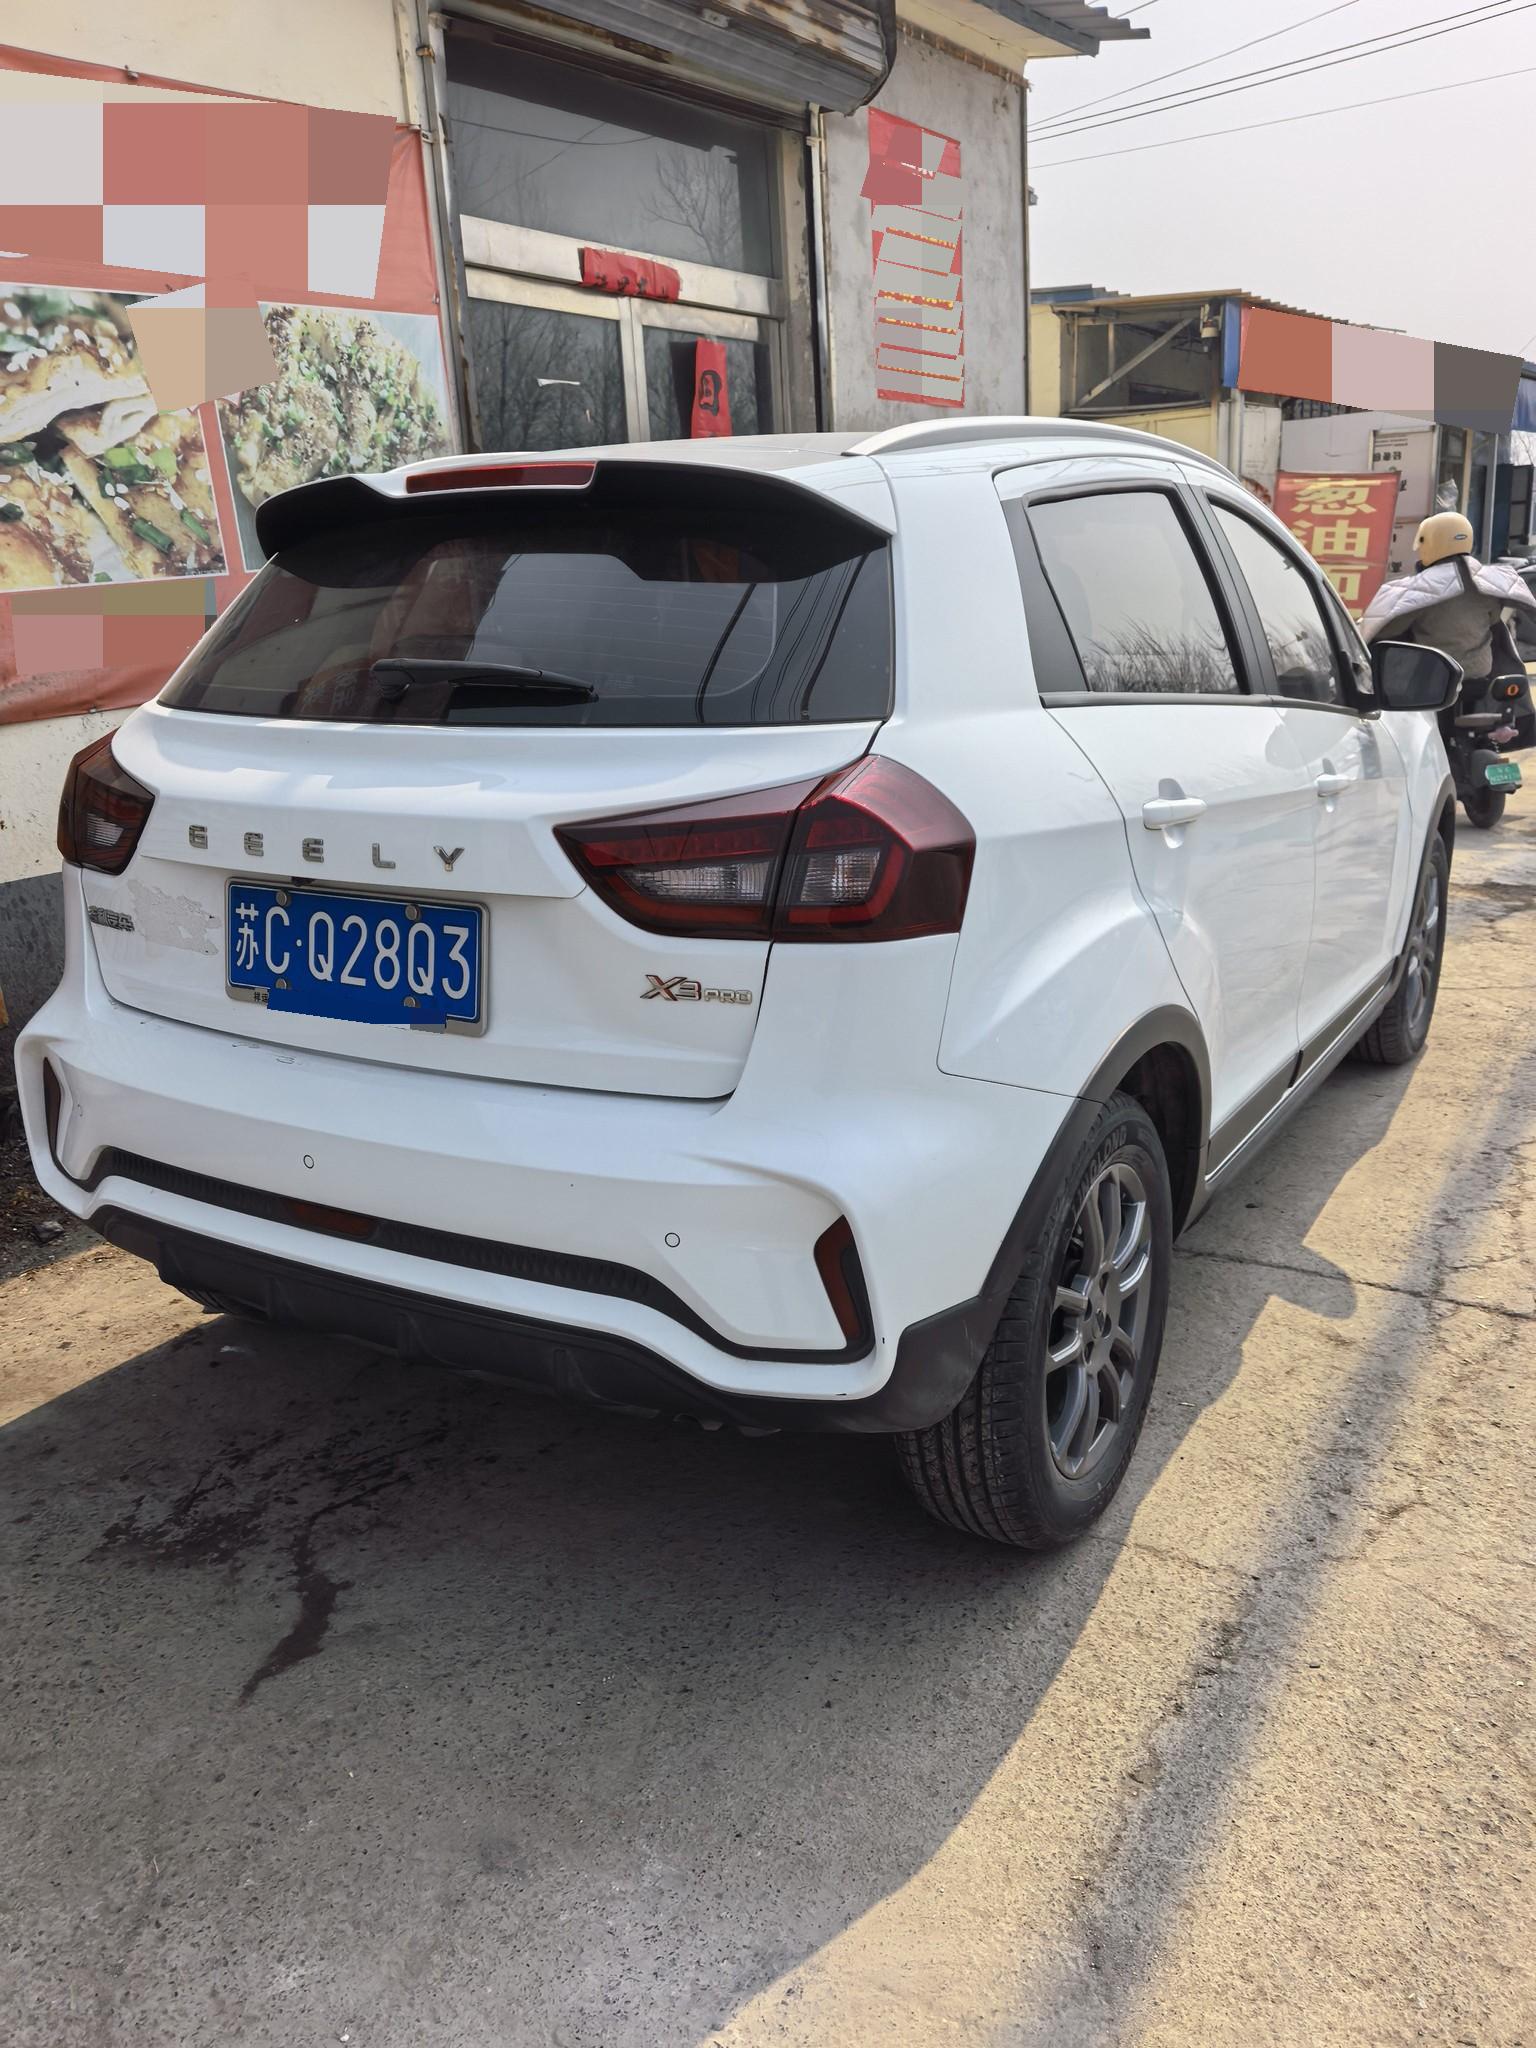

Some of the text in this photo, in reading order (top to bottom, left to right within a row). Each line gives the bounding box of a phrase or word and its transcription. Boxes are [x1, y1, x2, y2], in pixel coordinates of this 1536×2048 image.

[188, 824, 465, 872] GEELY
[640, 974, 753, 1005] X3 PRO
